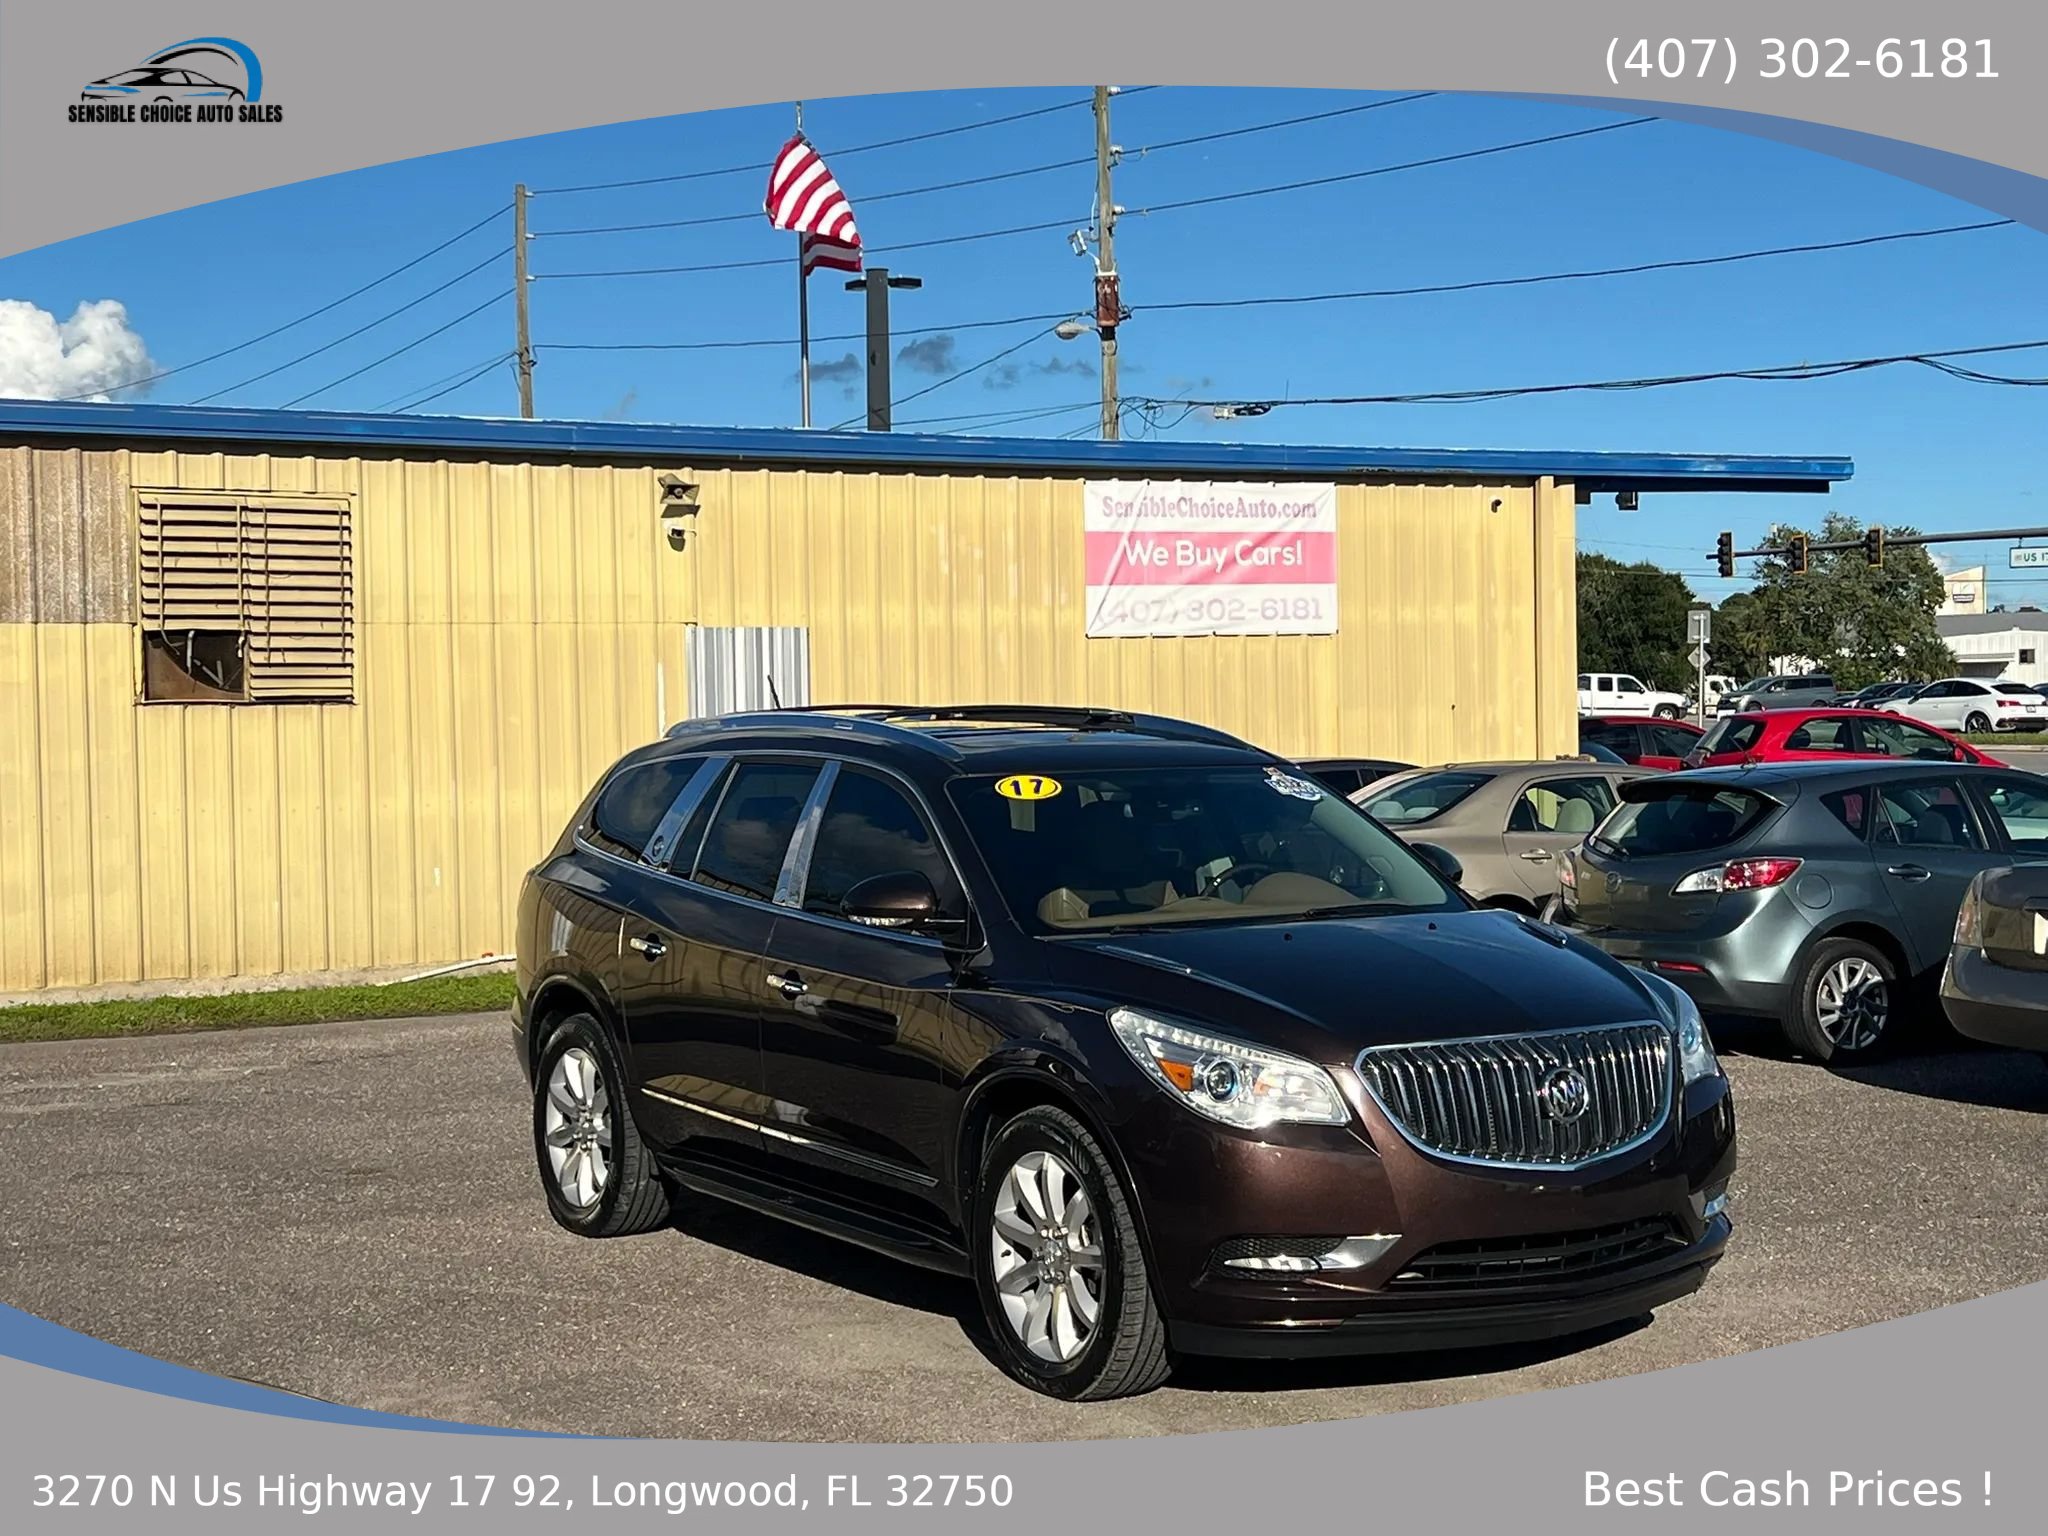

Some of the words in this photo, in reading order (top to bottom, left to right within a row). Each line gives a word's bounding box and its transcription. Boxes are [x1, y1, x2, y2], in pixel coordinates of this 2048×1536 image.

[1123, 539, 1169, 567] We
[1176, 539, 1228, 573] Buy
[1235, 539, 1303, 567] Cars!
[2023, 552, 2037, 562] US
[1010, 778, 1043, 796] 17
